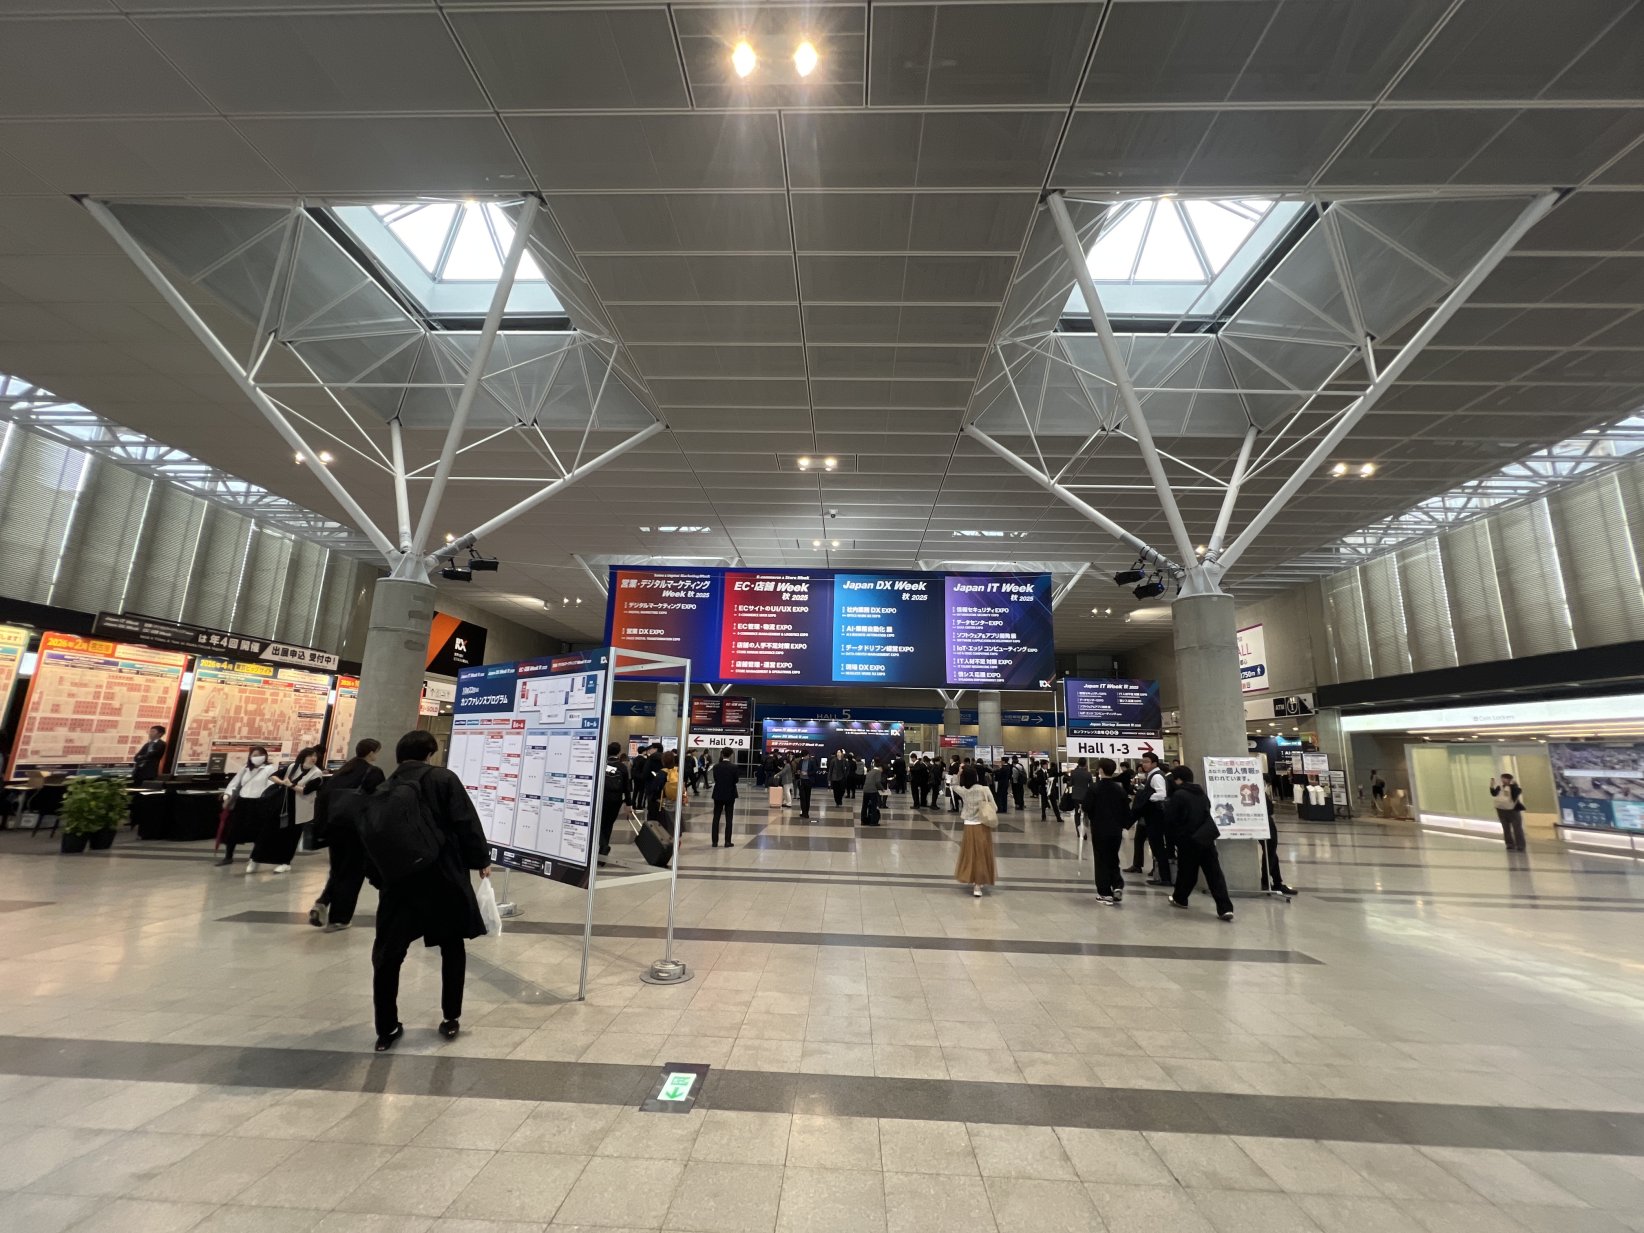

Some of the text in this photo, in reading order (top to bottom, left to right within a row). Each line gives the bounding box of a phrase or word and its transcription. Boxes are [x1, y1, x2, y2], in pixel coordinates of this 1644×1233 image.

[777, 583, 809, 591] Week
[843, 581, 927, 590] Japan DX Week
[953, 583, 1034, 592] Japan IT Week
[198, 634, 207, 643] は
[272, 646, 305, 660] 出展申込
[461, 695, 508, 706] カンファレンスプログラム
[842, 709, 851, 720] 5
[1078, 743, 1130, 754] Hall 1-3
